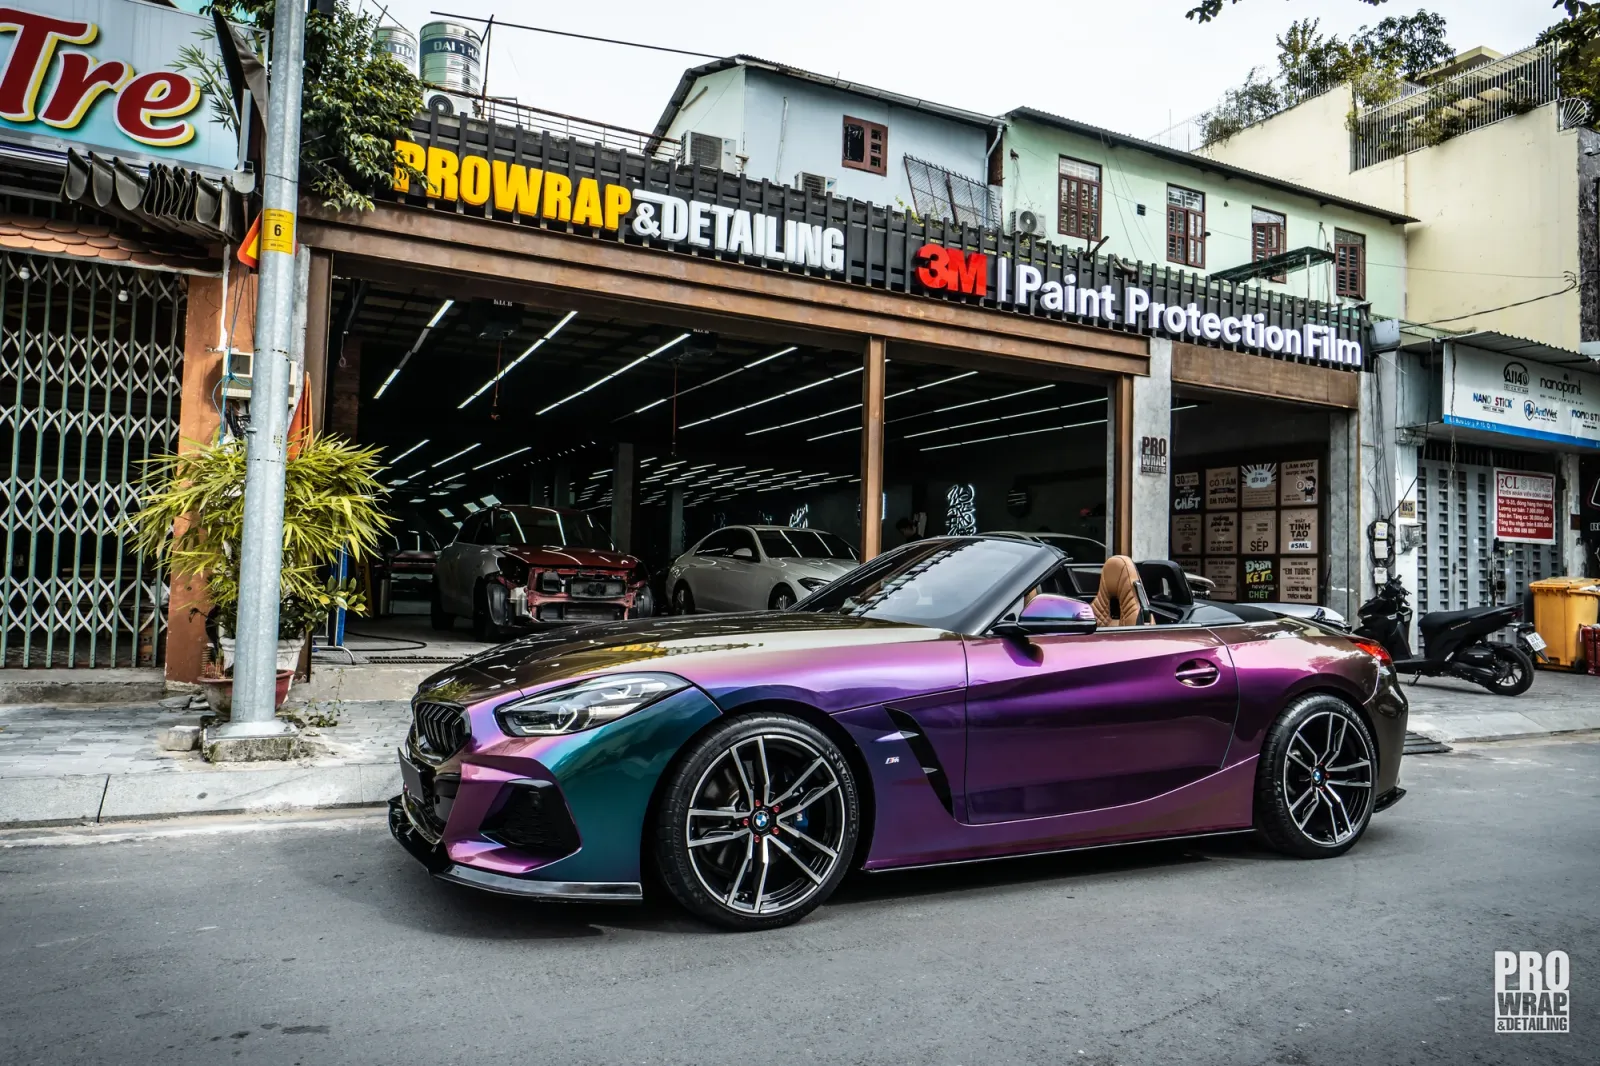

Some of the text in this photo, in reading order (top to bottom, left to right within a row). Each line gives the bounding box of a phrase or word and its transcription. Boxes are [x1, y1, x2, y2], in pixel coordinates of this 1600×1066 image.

[0, 8, 201, 147] Tre
[393, 140, 632, 232] PROWRAP
[274, 224, 282, 237] 6
[915, 243, 988, 298] 3M
[1015, 263, 1117, 322] Paint
[1142, 436, 1167, 456] PRO
